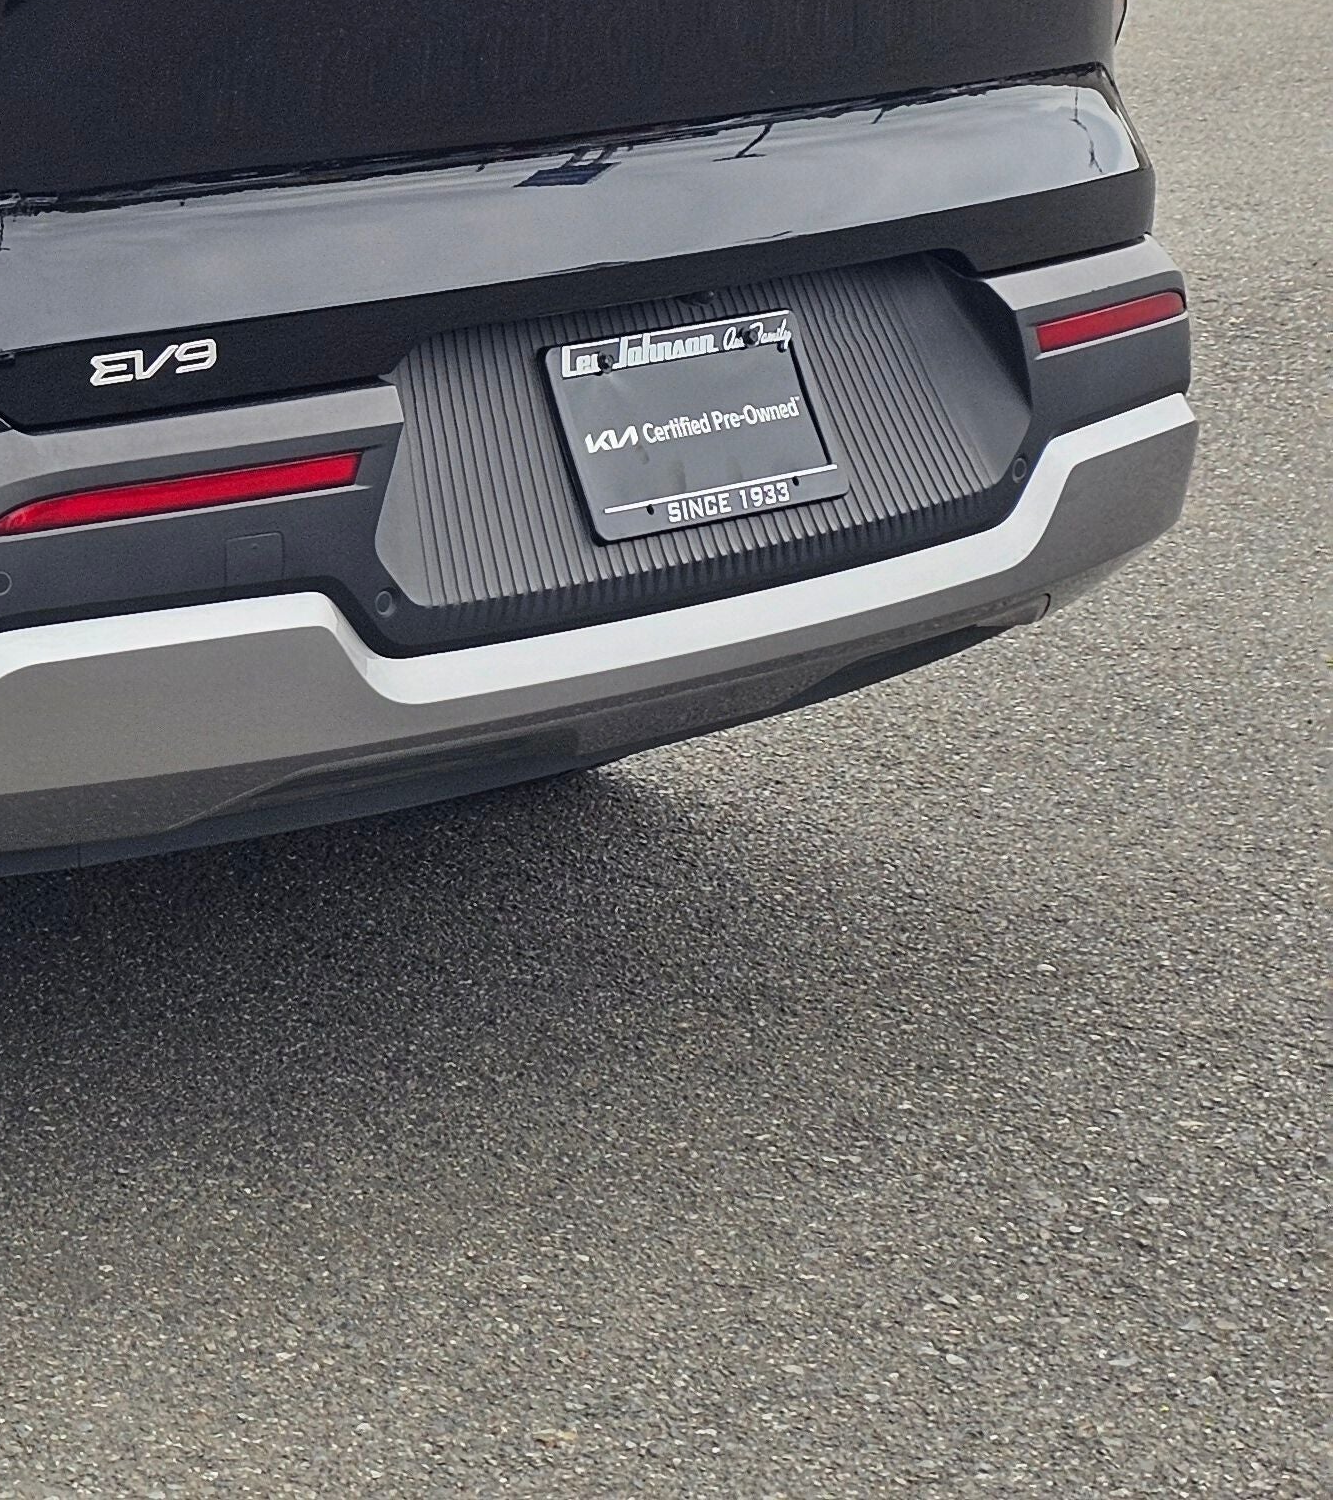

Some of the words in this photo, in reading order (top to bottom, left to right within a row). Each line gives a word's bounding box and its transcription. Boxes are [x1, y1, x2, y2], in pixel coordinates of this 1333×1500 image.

[90, 338, 217, 387] EV9
[613, 331, 720, 370] Johnson
[584, 425, 639, 454] KIA
[642, 412, 712, 444] Certified
[667, 492, 732, 523] SINCE
[739, 481, 790, 510] 1933
